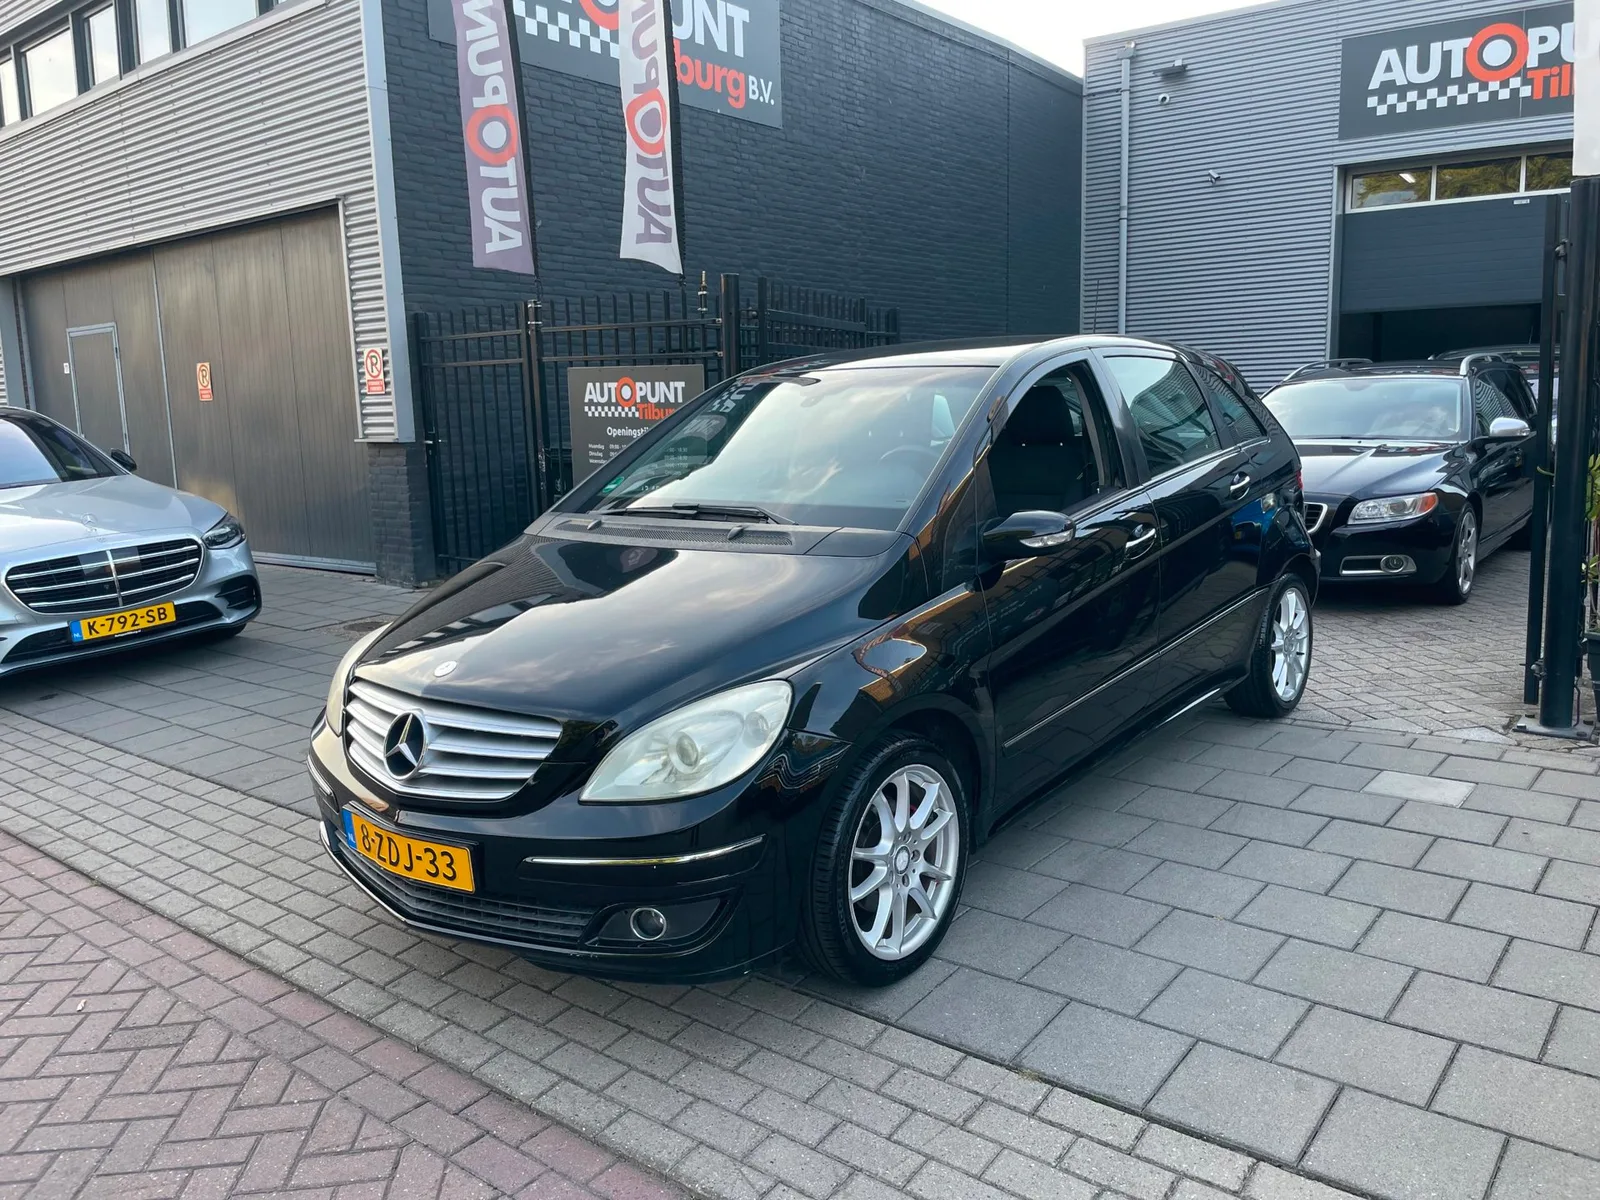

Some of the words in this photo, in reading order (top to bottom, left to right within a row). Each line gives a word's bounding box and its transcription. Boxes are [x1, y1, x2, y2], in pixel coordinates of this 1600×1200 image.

[670, 0, 750, 58] UNT
[748, 74, 775, 105] B.V.
[1526, 64, 1575, 100] Til
[584, 377, 685, 408] AUTOPUNT
[87, 607, 168, 636] K-792-SB
[360, 823, 457, 882] 8-ZDJ-33
